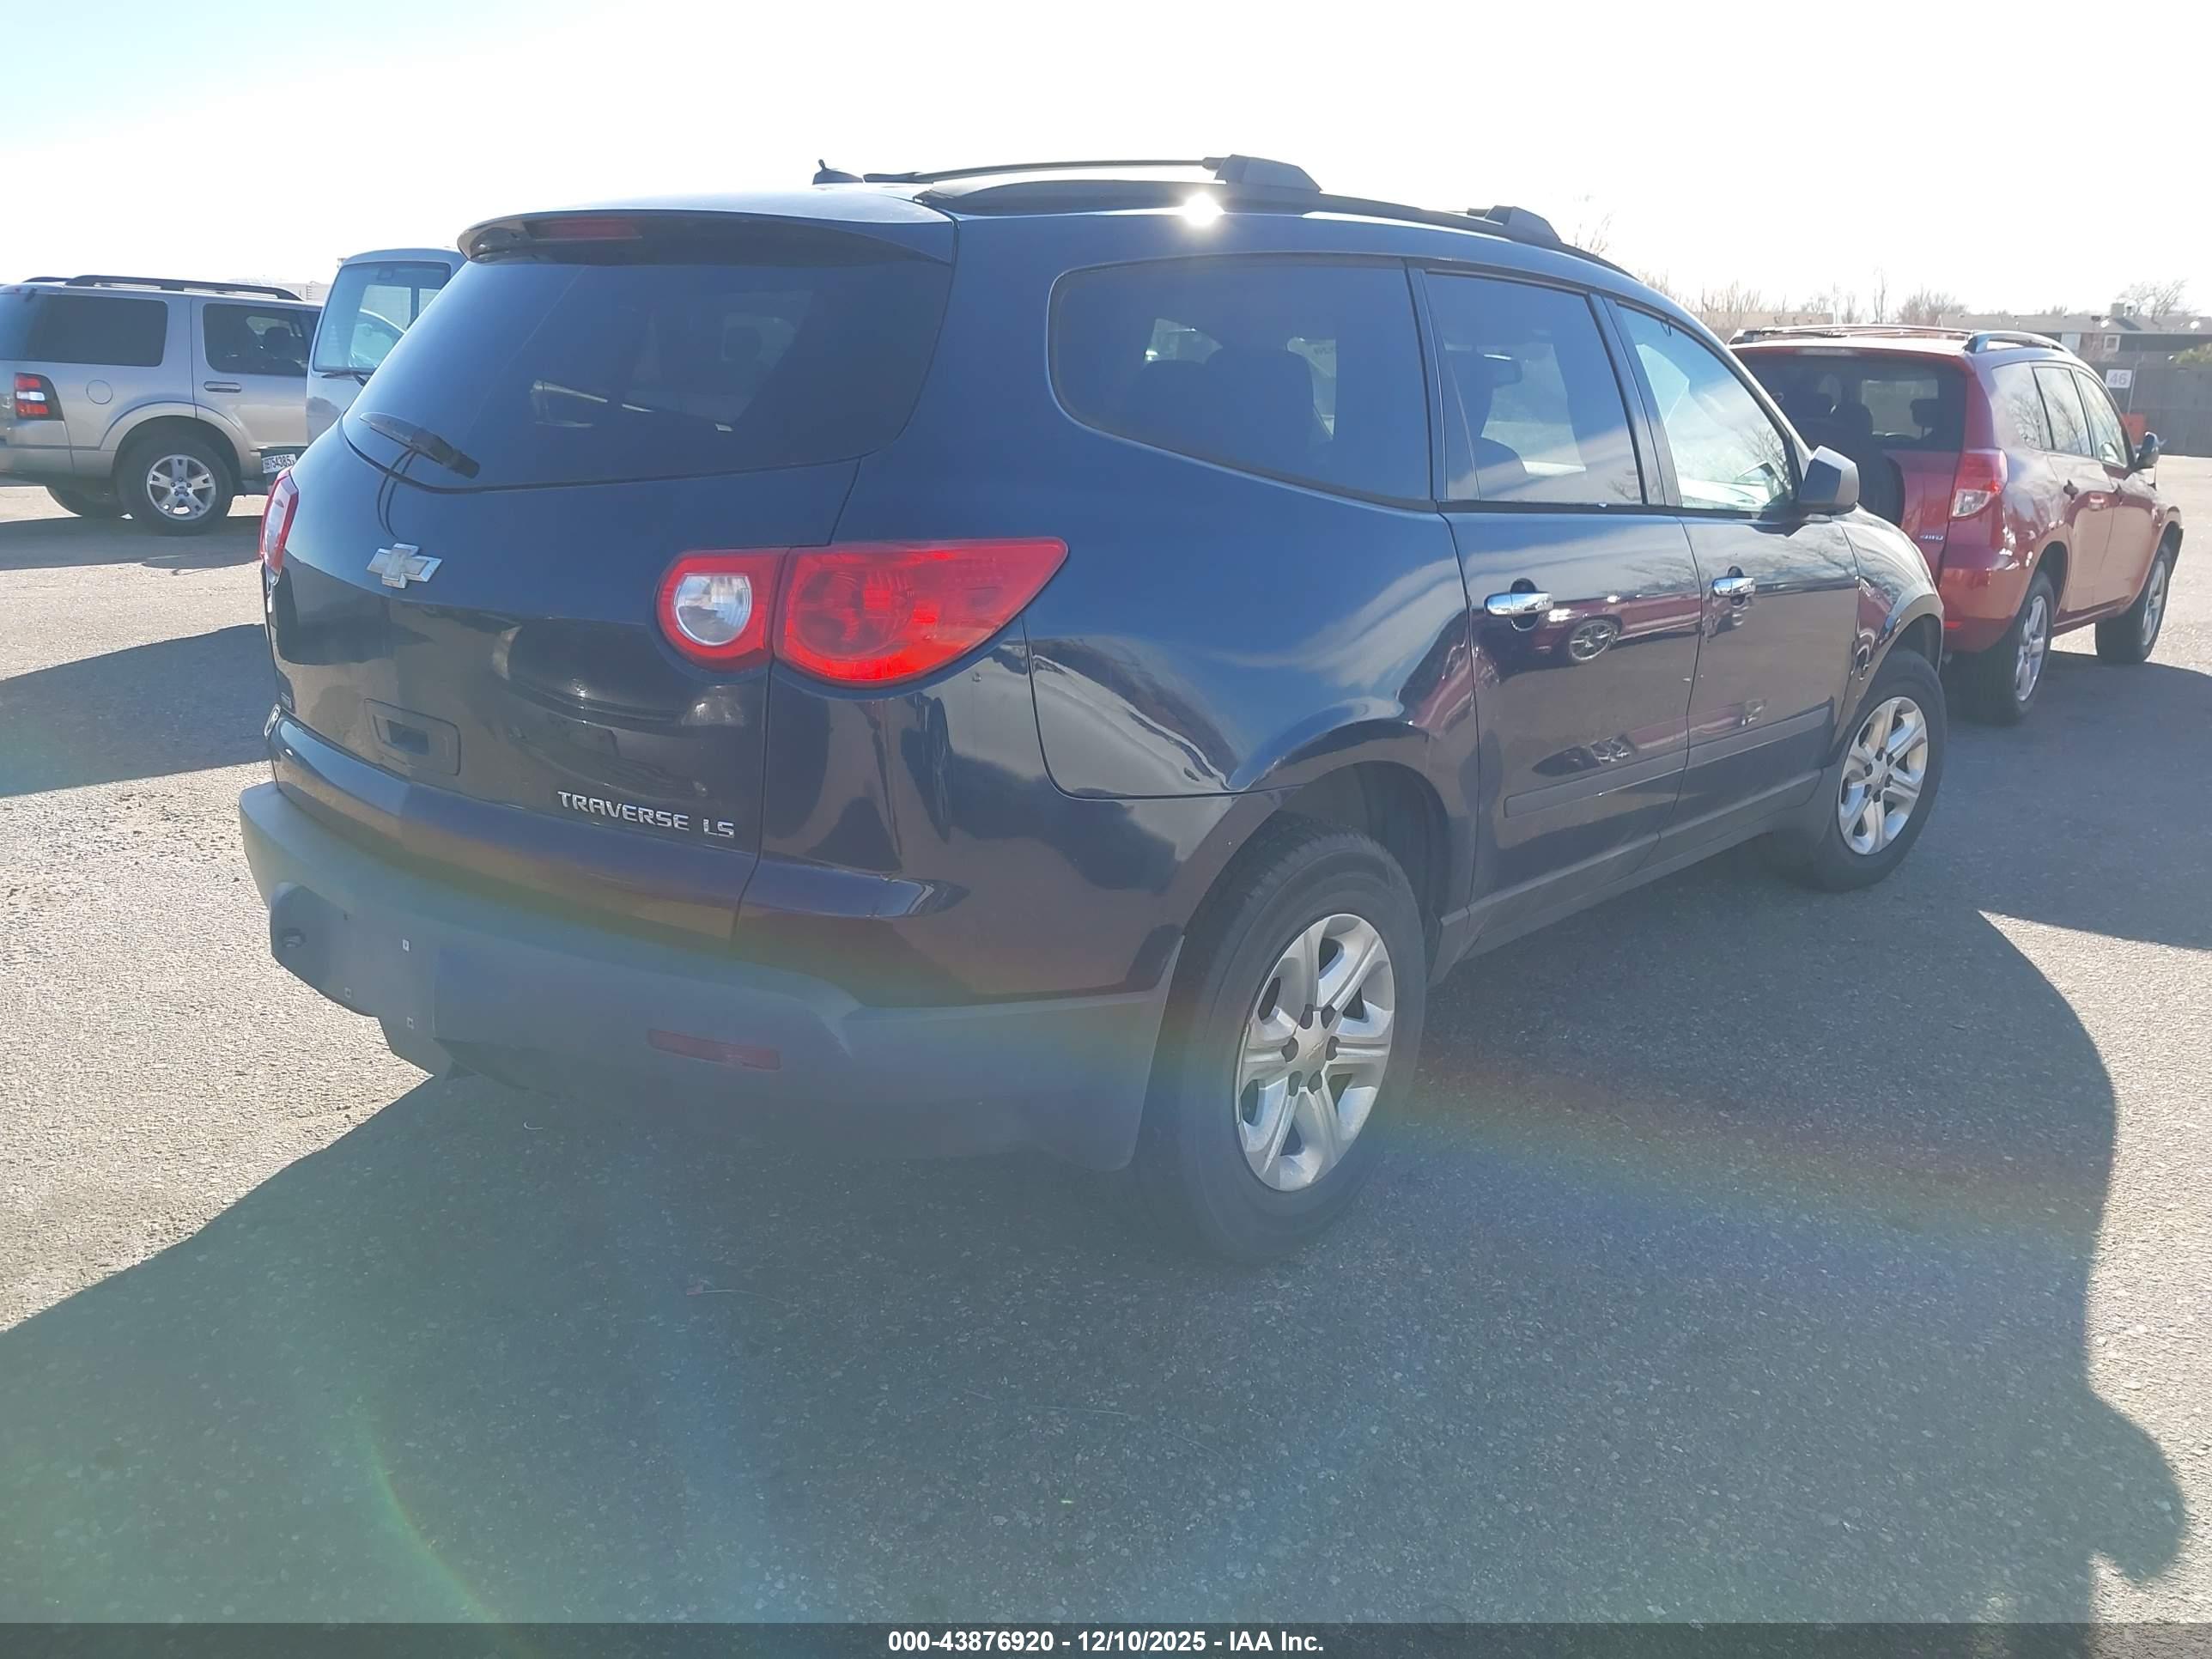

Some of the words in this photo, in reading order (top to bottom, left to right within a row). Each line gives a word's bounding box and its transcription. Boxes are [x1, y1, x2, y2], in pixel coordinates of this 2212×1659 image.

[2109, 372, 2128, 386] 46
[557, 791, 690, 831] TRAVERSE
[703, 818, 735, 838] LS
